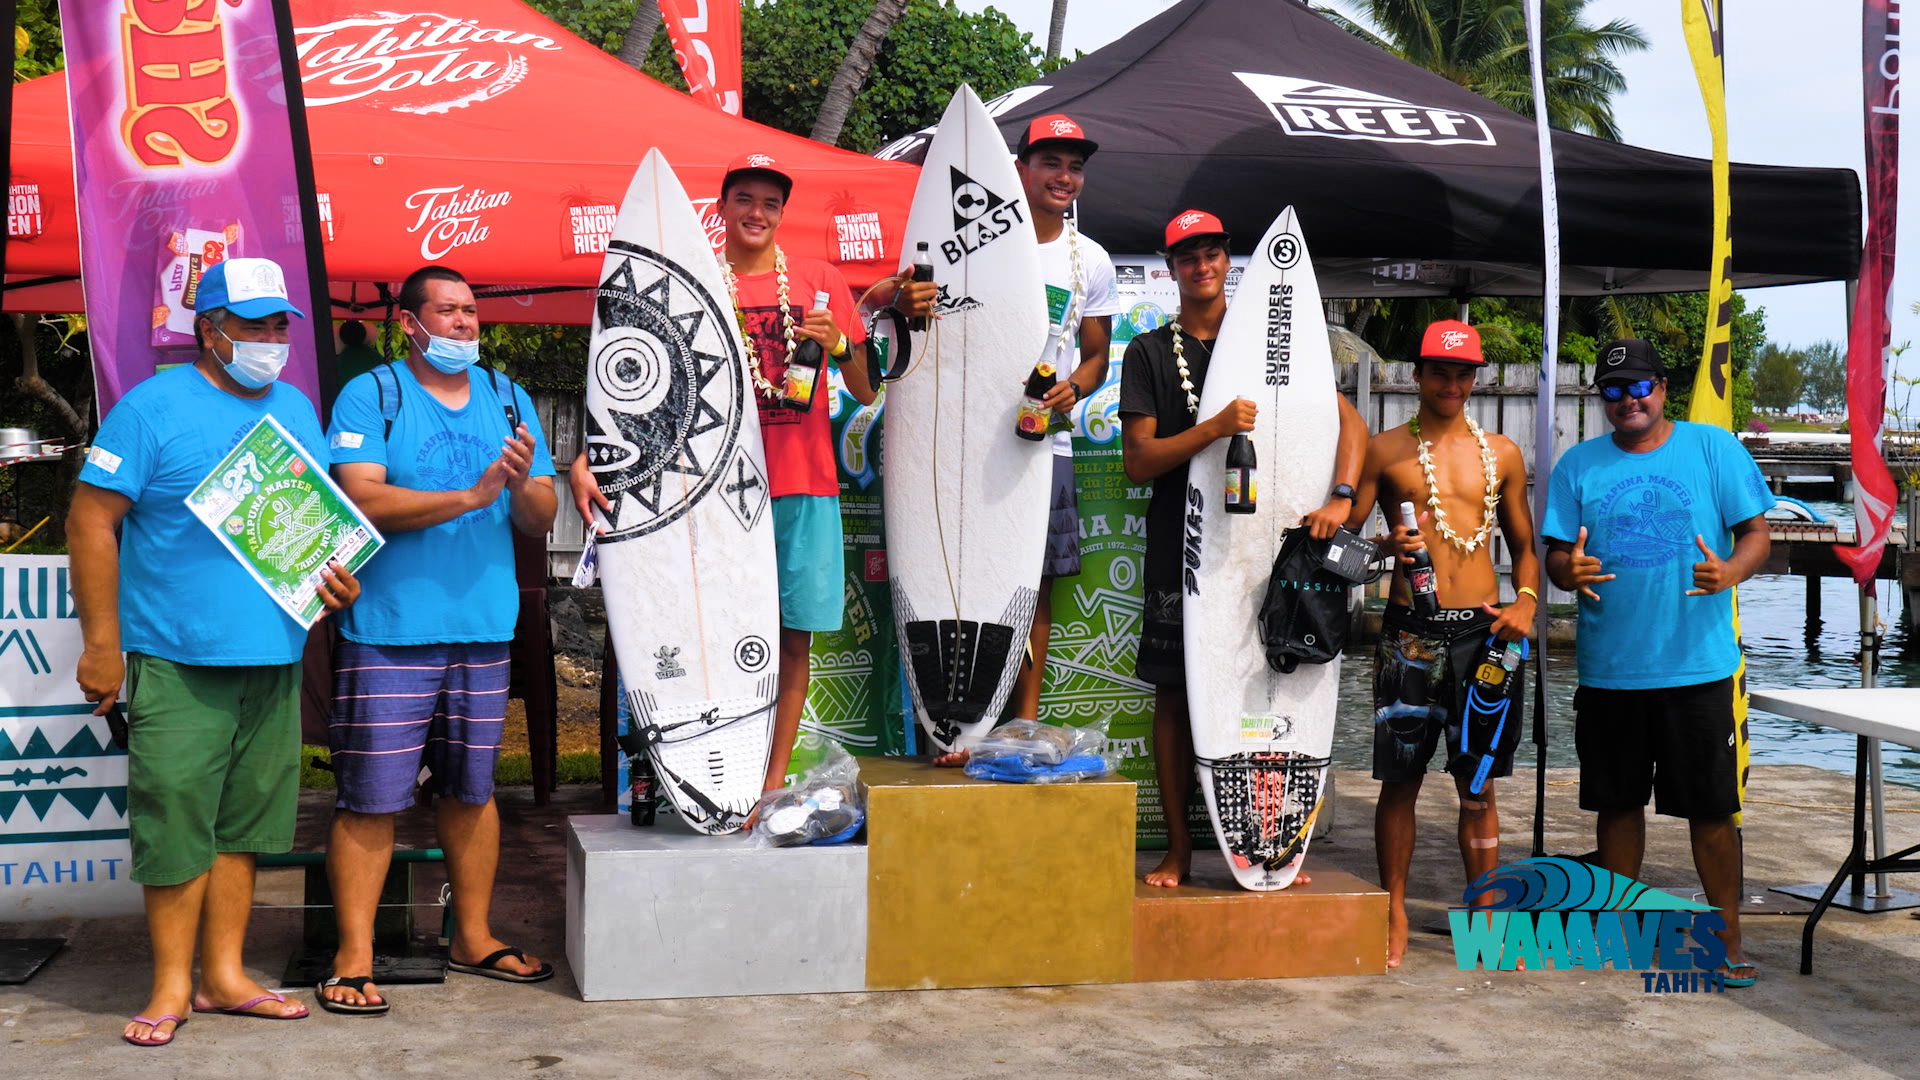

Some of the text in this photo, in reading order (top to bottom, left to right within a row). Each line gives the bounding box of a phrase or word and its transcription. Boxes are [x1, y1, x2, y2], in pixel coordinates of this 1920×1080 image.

[294, 14, 563, 68] Tahitian
[302, 48, 501, 107] Cola
[1282, 104, 1467, 137] REEF
[405, 184, 513, 233] Tahitian
[569, 204, 617, 216] UN TAHITIAN
[571, 215, 617, 234] SINON
[834, 212, 879, 224] UN TAHITIAN
[420, 215, 491, 261] Cola
[573, 234, 610, 255] RIEN
[836, 222, 882, 242] SINON
[940, 199, 1024, 266] BLAST
[839, 240, 885, 261] RIEN !
[1266, 284, 1281, 386] SURFRIDER
[1278, 284, 1293, 387] SURFRIDER
[223, 451, 264, 501] 27
[1083, 476, 1122, 488] du 27
[1083, 490, 1101, 500] au
[1105, 488, 1122, 499] 30
[1598, 474, 1693, 517] TAAPUNA MASTER
[246, 495, 266, 553] TAAPUNA
[264, 479, 313, 496] MASTER
[294, 528, 333, 573] TAHITI NUI
[1184, 482, 1204, 597] PUKAS
[1280, 580, 1342, 593] VISSLA
[844, 582, 872, 646] TER
[1426, 610, 1475, 621] ERO
[655, 668, 686, 680] VIPER
[1481, 665, 1492, 680] 6
[0, 858, 124, 887] TAHIT
